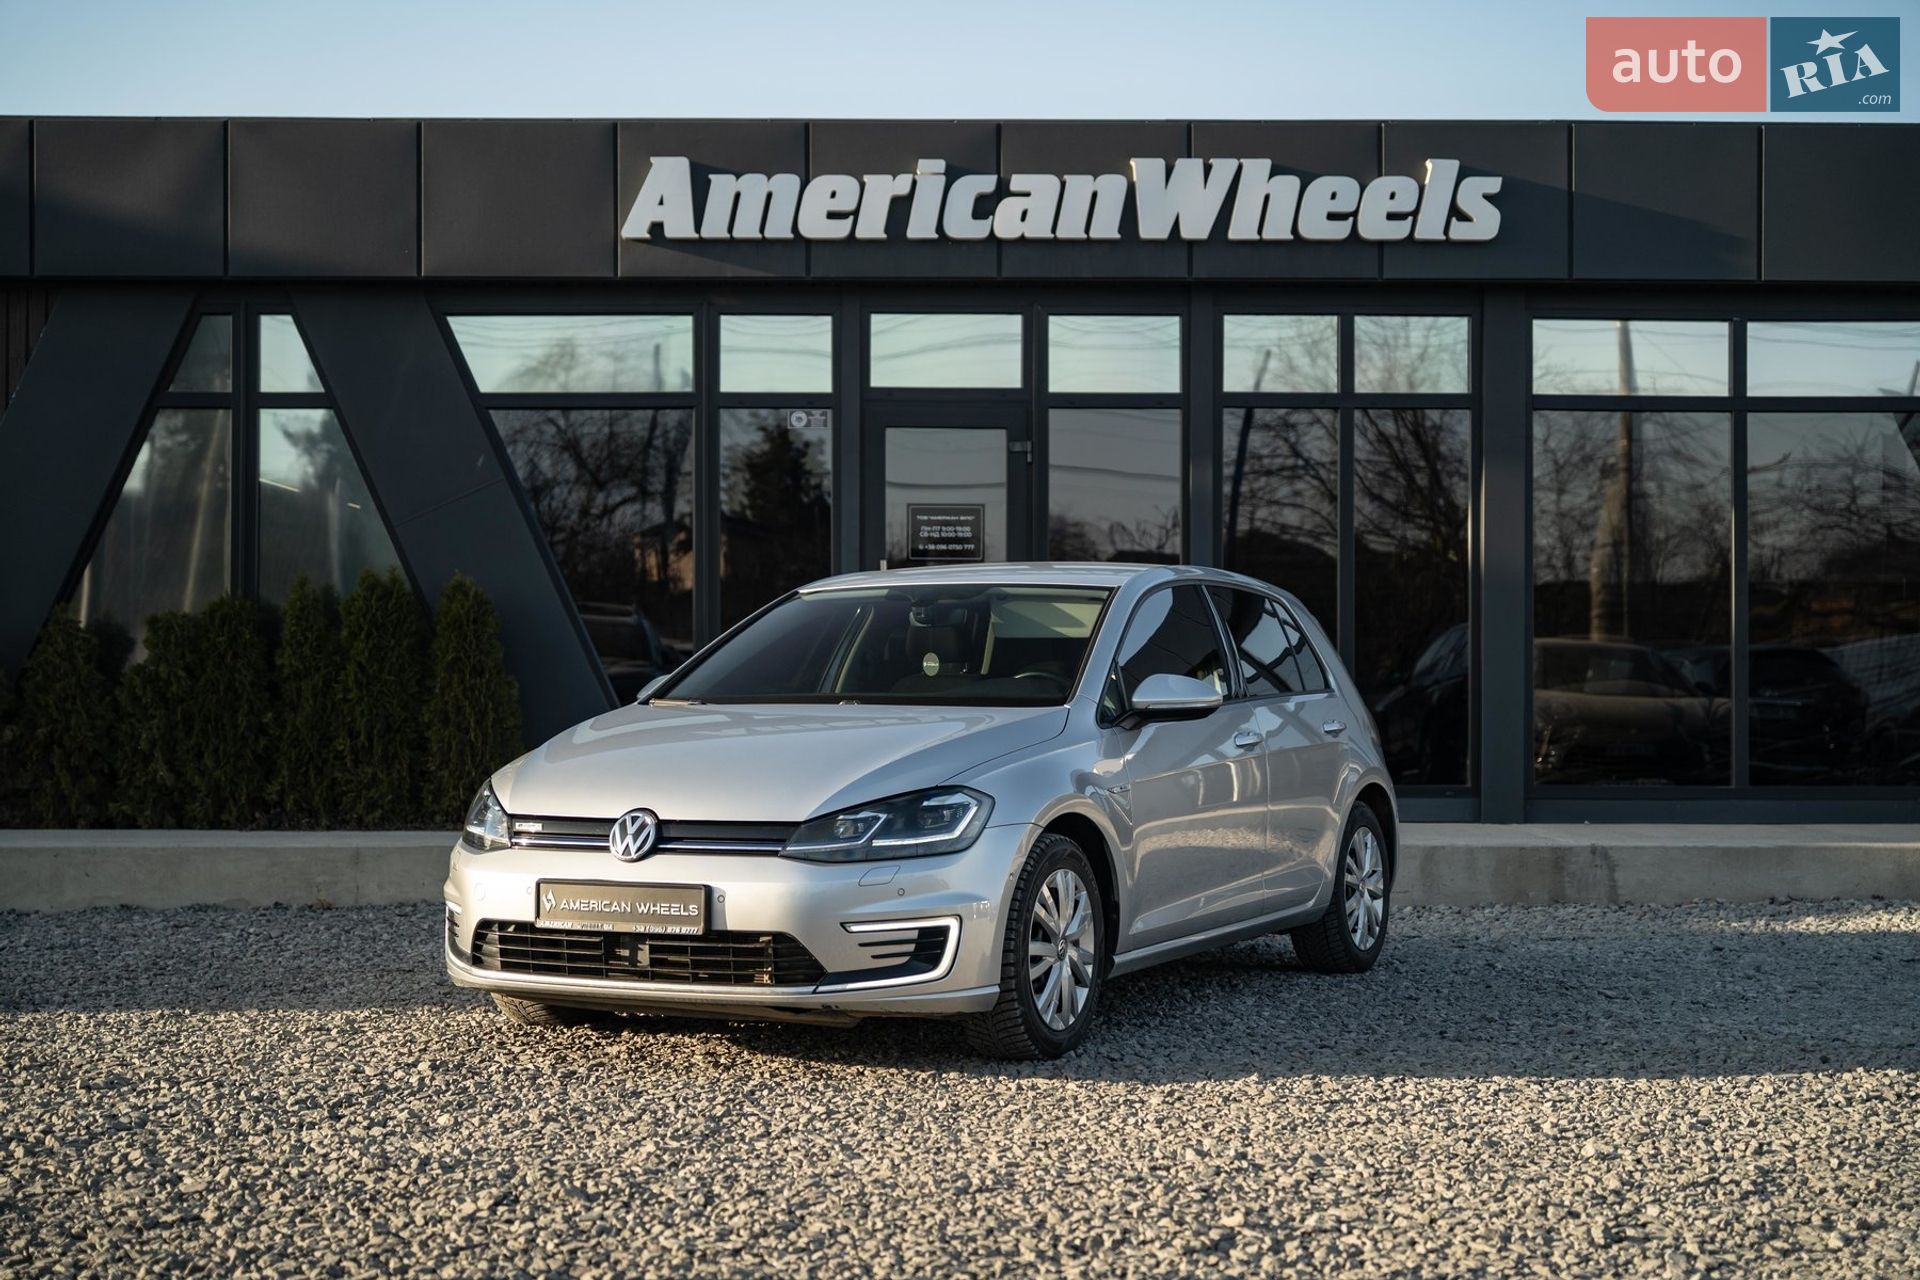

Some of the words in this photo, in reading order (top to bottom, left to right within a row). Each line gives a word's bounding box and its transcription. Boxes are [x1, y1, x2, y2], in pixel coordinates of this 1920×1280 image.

[620, 156, 1502, 242] AmericanWheels
[560, 899, 631, 913] AMERICAN
[636, 902, 699, 916] WHEELS
